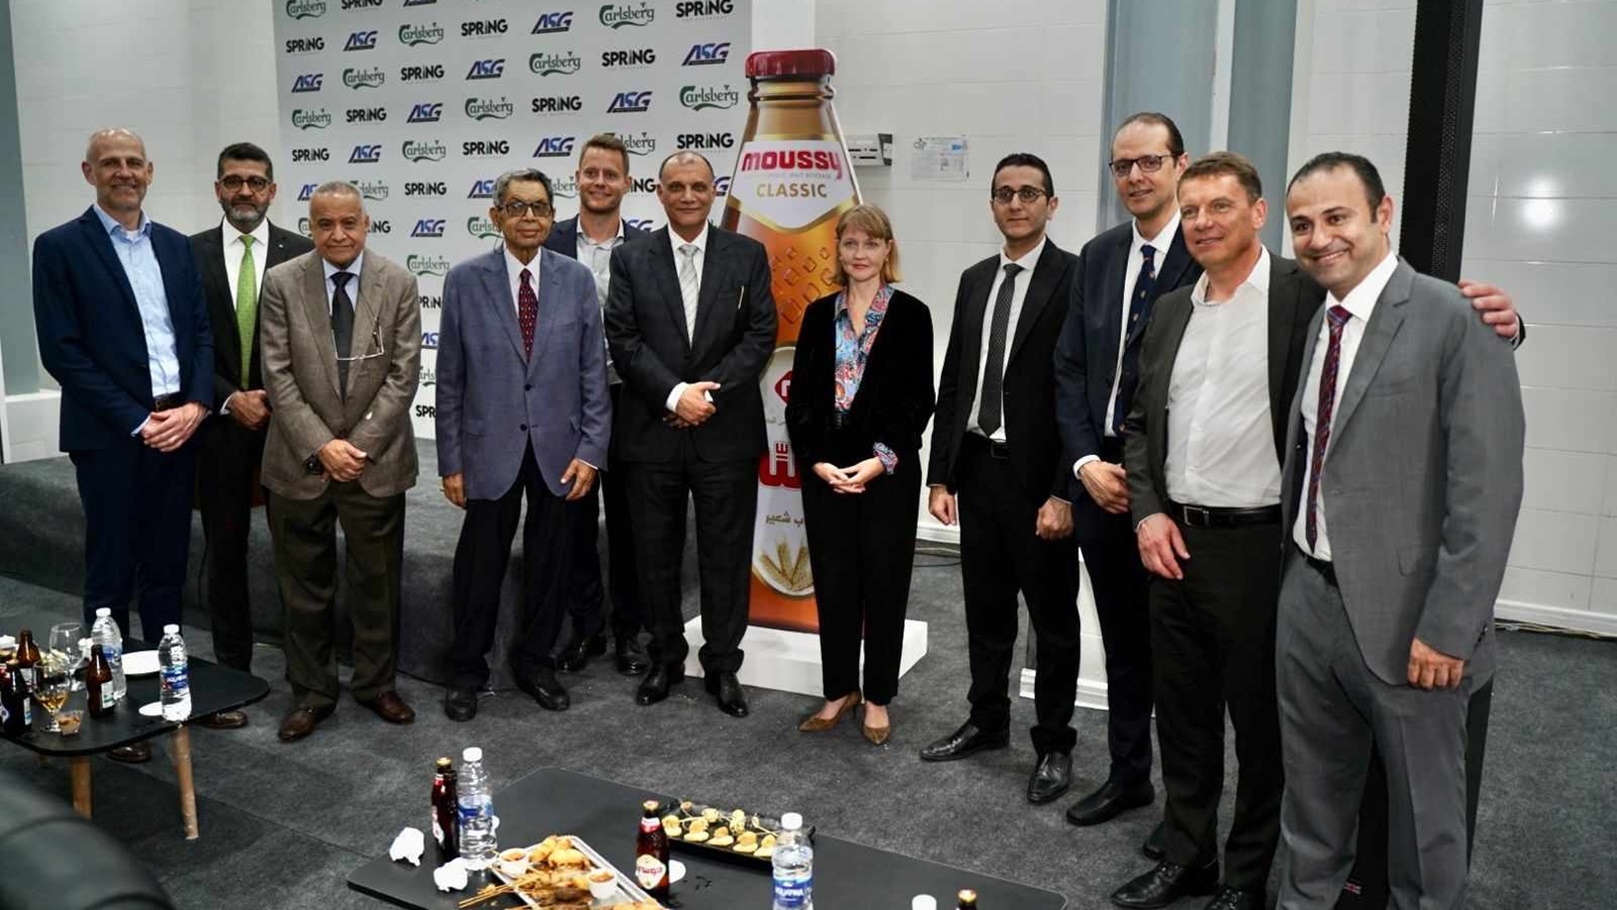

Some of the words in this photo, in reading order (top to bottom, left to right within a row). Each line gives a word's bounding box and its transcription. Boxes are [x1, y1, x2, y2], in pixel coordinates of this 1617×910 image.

[286, 0, 326, 19] Carlsberg
[599, 2, 655, 29] Carlsberg
[531, 12, 574, 34] ASG
[343, 30, 378, 51] ASG
[399, 23, 444, 46] Carlsberg
[529, 51, 581, 76] Carlsberg
[681, 42, 731, 66] ASG
[342, 67, 385, 90] Carlsberg
[465, 58, 506, 80] ASG
[291, 73, 324, 93] ASG
[607, 91, 653, 113] ASG
[679, 84, 739, 111] Carlsberg
[292, 108, 331, 130] Carlsberg
[406, 103, 443, 123] ASG
[465, 97, 513, 121] Carlsberg
[348, 145, 382, 164] ASG
[402, 140, 447, 162] Carlsberg
[533, 137, 575, 158] ASG
[604, 132, 656, 155] lsberg
[757, 183, 827, 198] CLASSIC
[411, 219, 446, 237] ASG
[407, 254, 450, 276] Carlsberg
